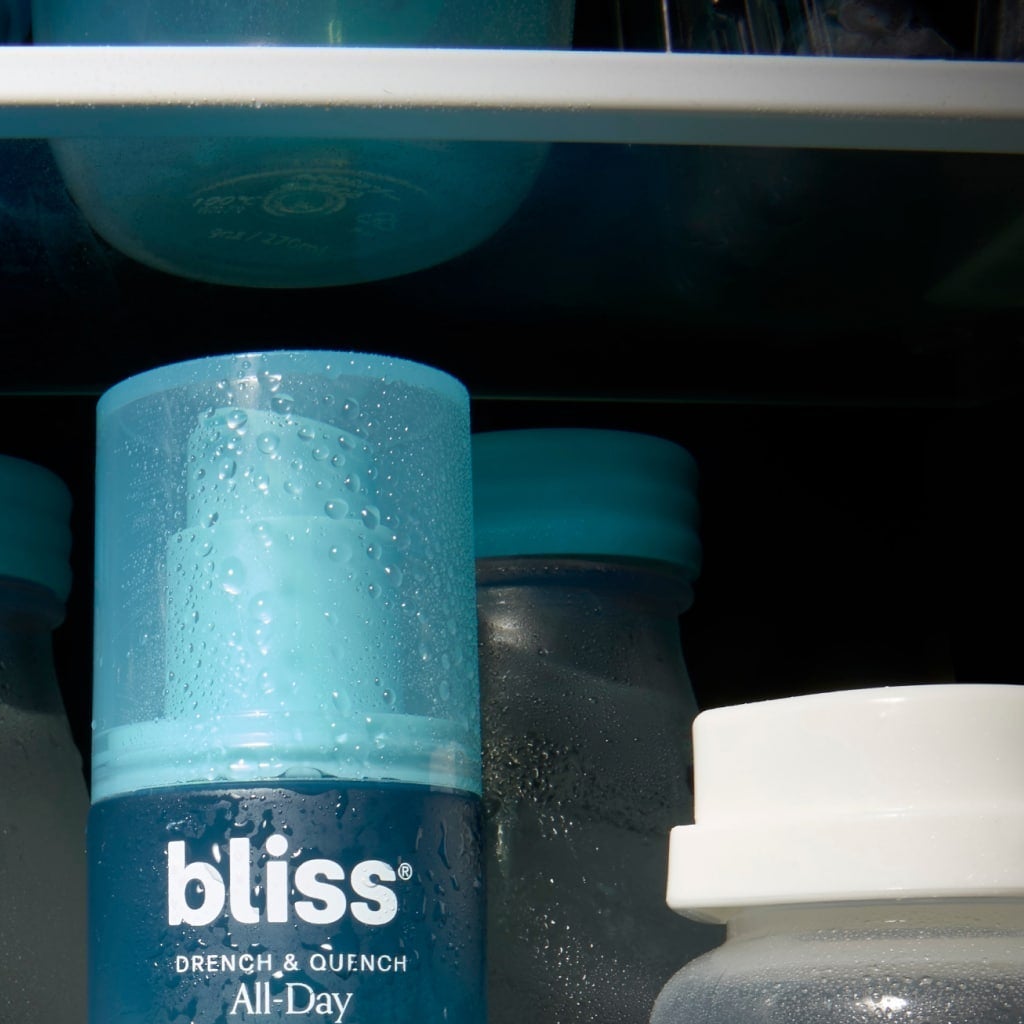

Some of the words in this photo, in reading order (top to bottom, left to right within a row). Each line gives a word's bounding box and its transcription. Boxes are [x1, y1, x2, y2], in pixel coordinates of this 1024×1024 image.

[175, 953, 272, 974] DRENCH
[284, 954, 298, 972] &
[310, 953, 407, 973] QUENCH
[229, 981, 353, 1023] All-Day
